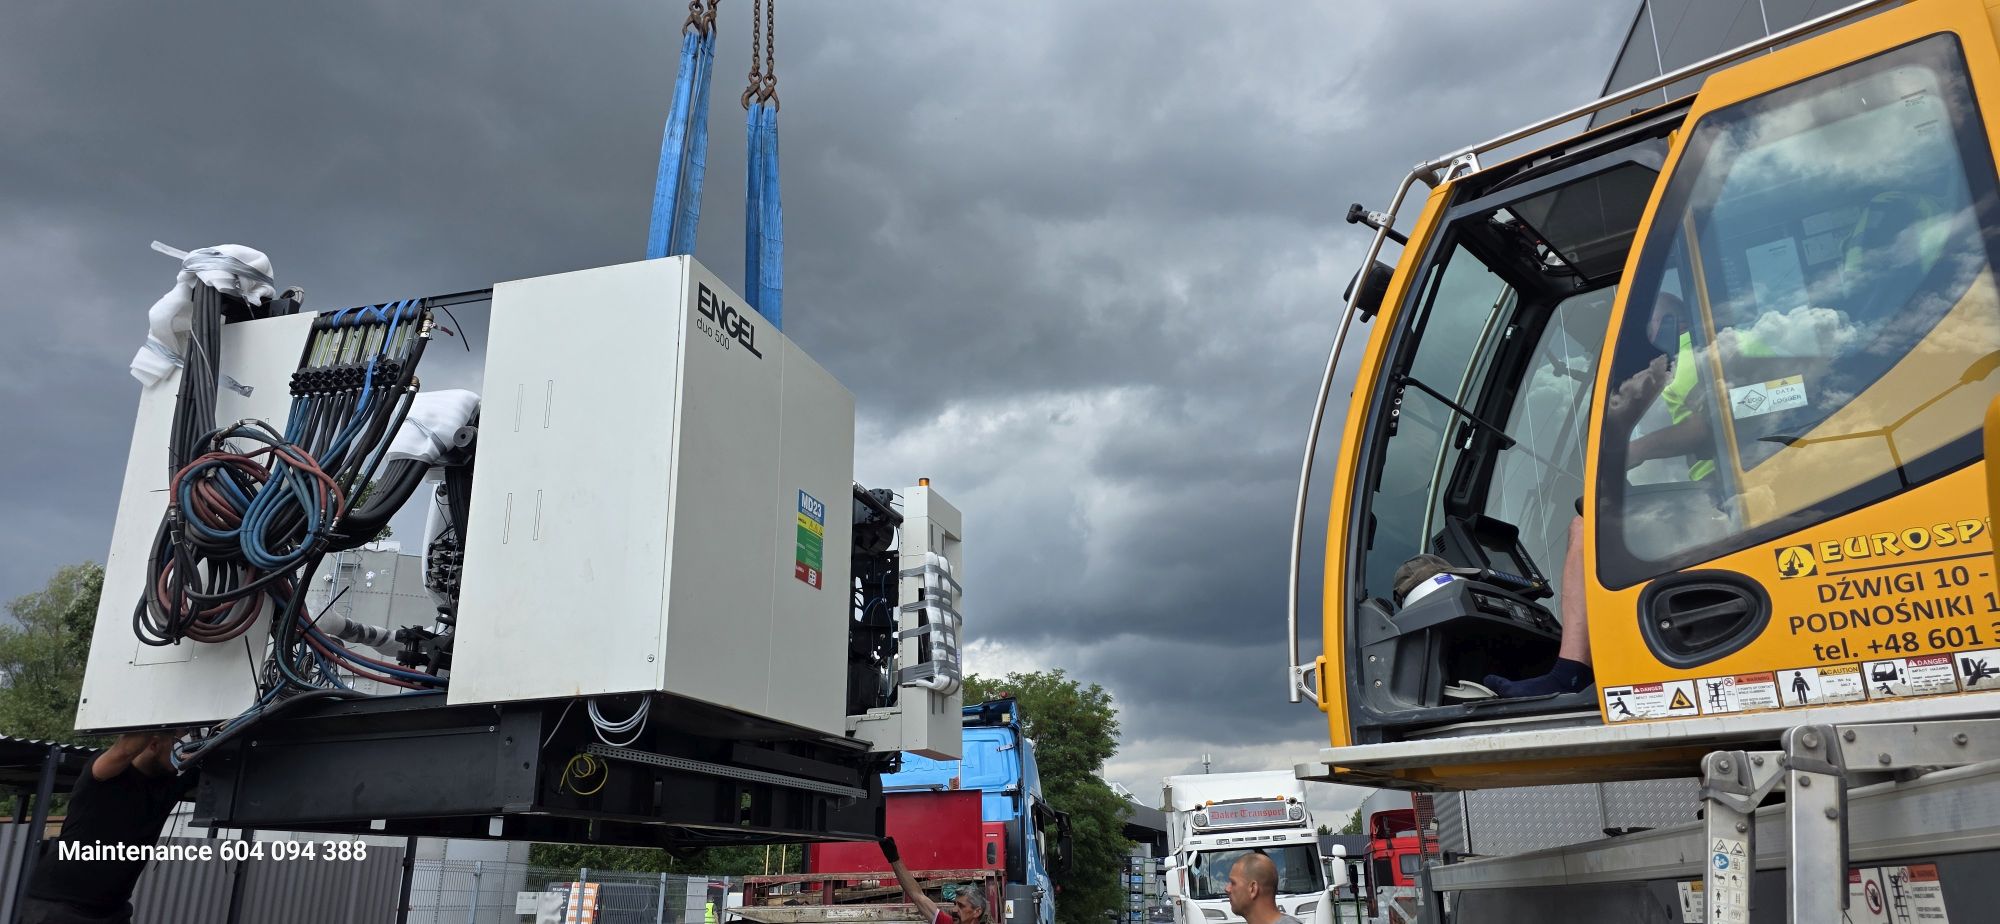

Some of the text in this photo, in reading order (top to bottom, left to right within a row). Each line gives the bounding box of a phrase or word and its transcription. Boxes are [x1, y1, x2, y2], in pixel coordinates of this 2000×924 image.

[697, 281, 762, 360] ENGEL
[696, 317, 730, 350] duo 500
[1775, 387, 1796, 395] DATA
[801, 493, 822, 518] MD23
[1817, 571, 1925, 604] DŹWIGI
[1933, 565, 1971, 589] 10
[1789, 594, 1974, 635] PODNOŚNIKI
[1812, 638, 1859, 661] tel.
[1867, 631, 1920, 654] +48
[1928, 625, 1984, 650] 601
[1826, 666, 1858, 675] CAUTION
[1917, 657, 1948, 666] DANGER
[1639, 685, 1663, 693] DANGER
[1210, 807, 1287, 820] Daker Transport
